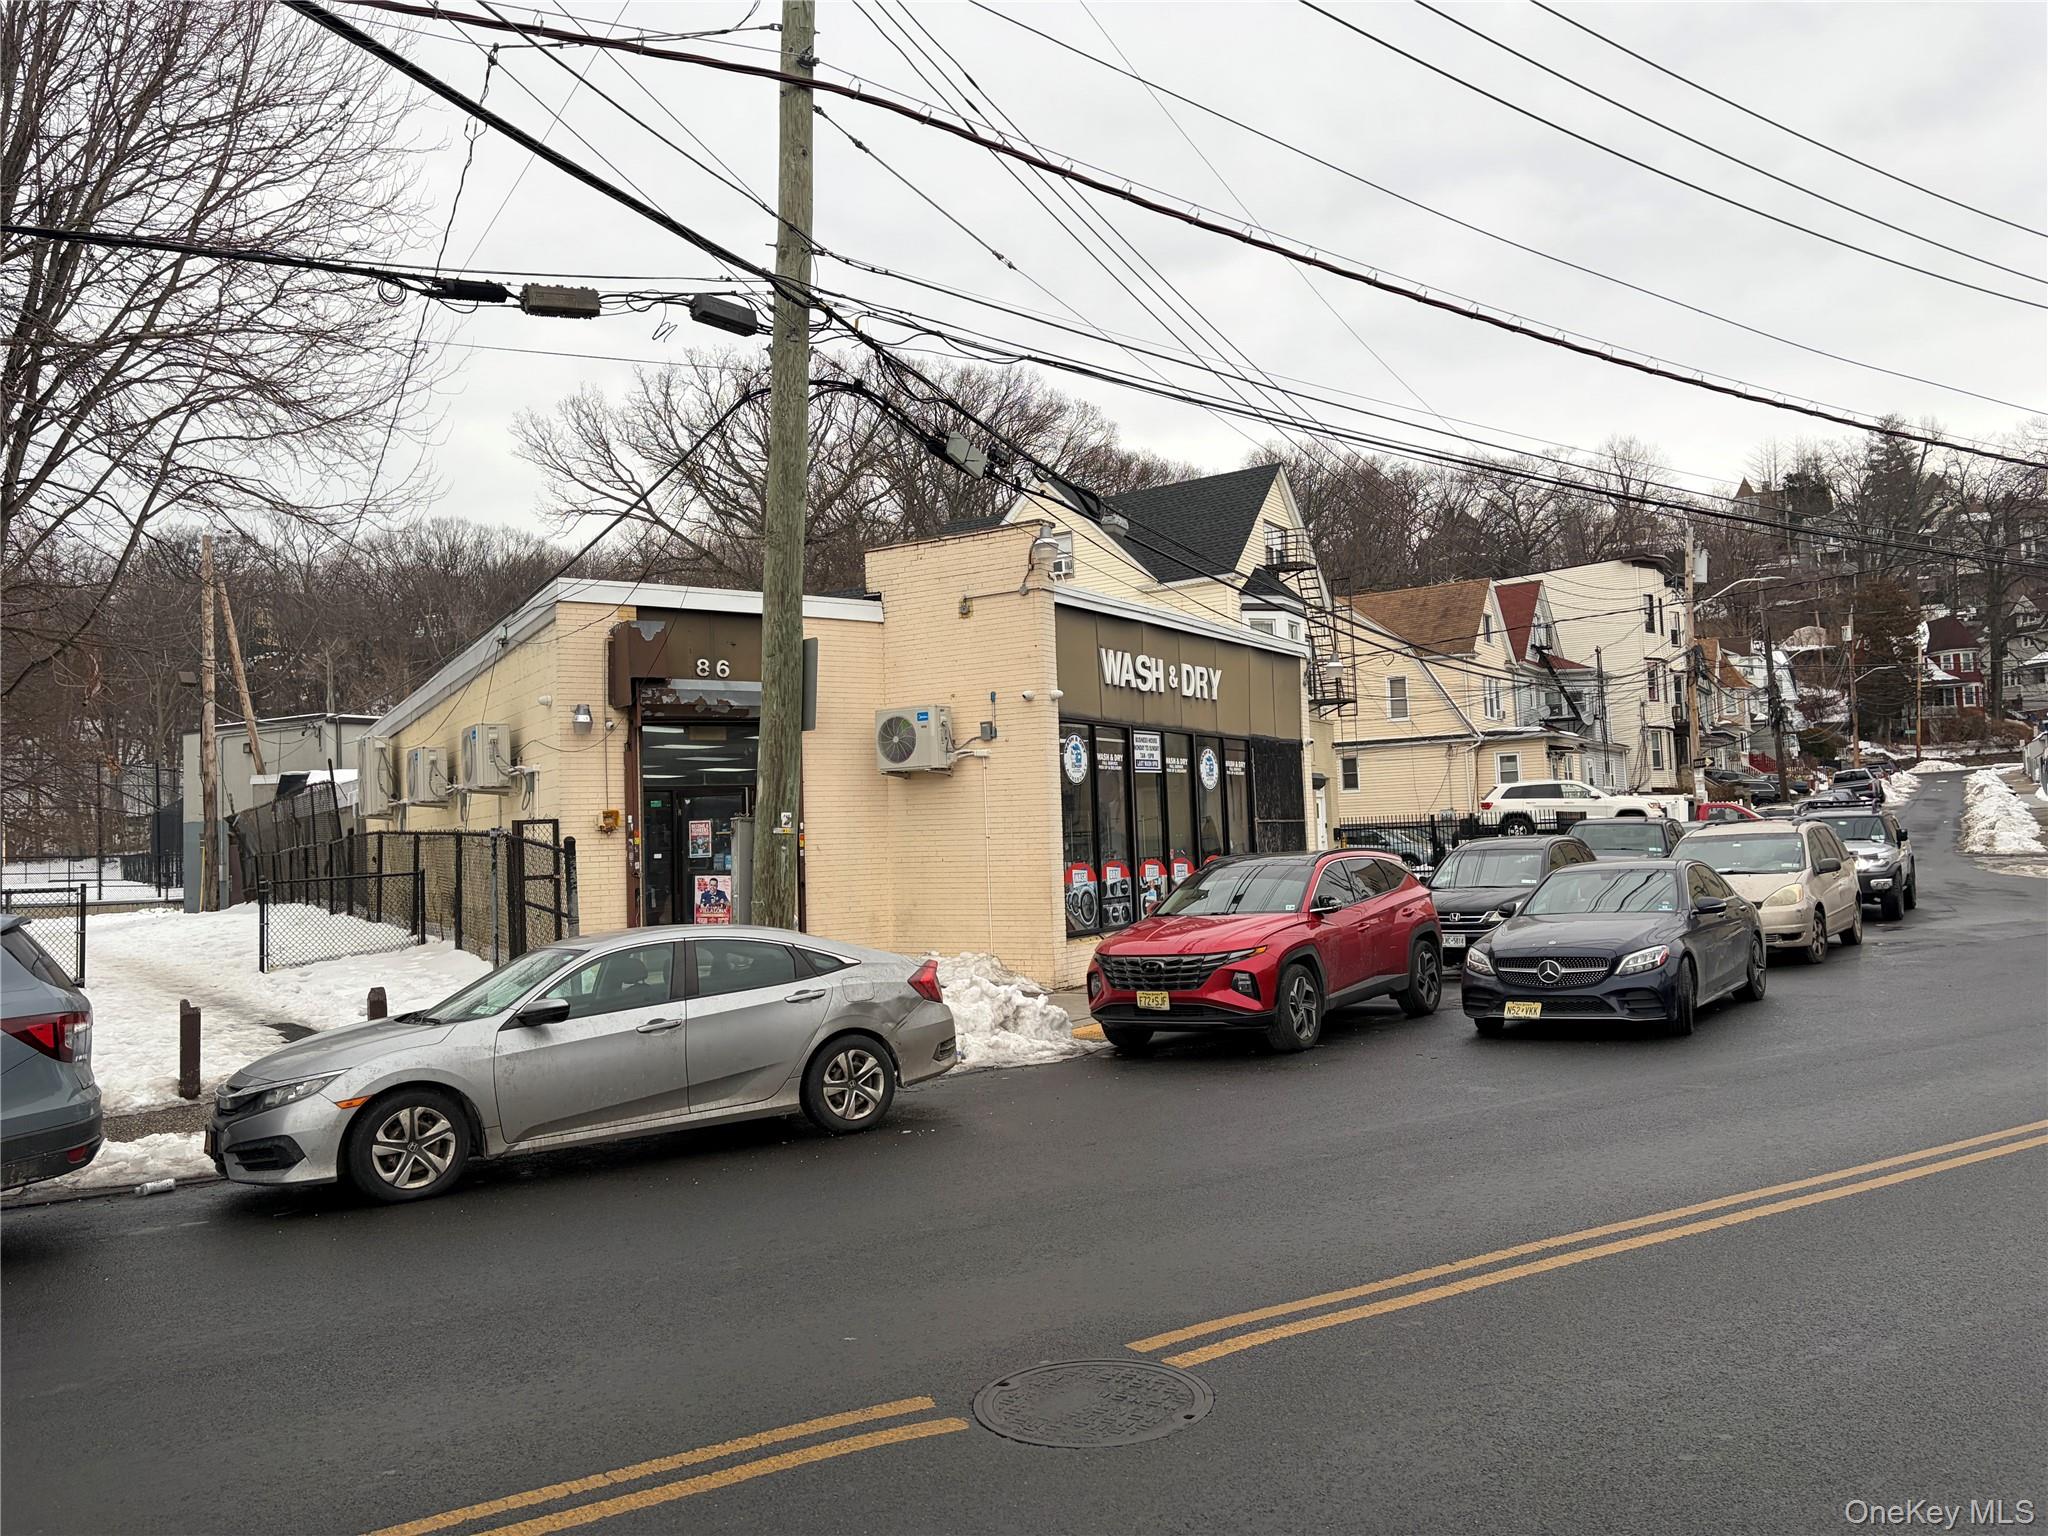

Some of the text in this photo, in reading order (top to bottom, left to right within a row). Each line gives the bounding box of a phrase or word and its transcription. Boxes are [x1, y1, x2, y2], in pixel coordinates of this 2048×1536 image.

[696, 658, 730, 678] 86
[1099, 648, 1222, 700] WASH & DRY
[1097, 753, 1109, 761] WASH
[1114, 753, 1123, 761] DRY
